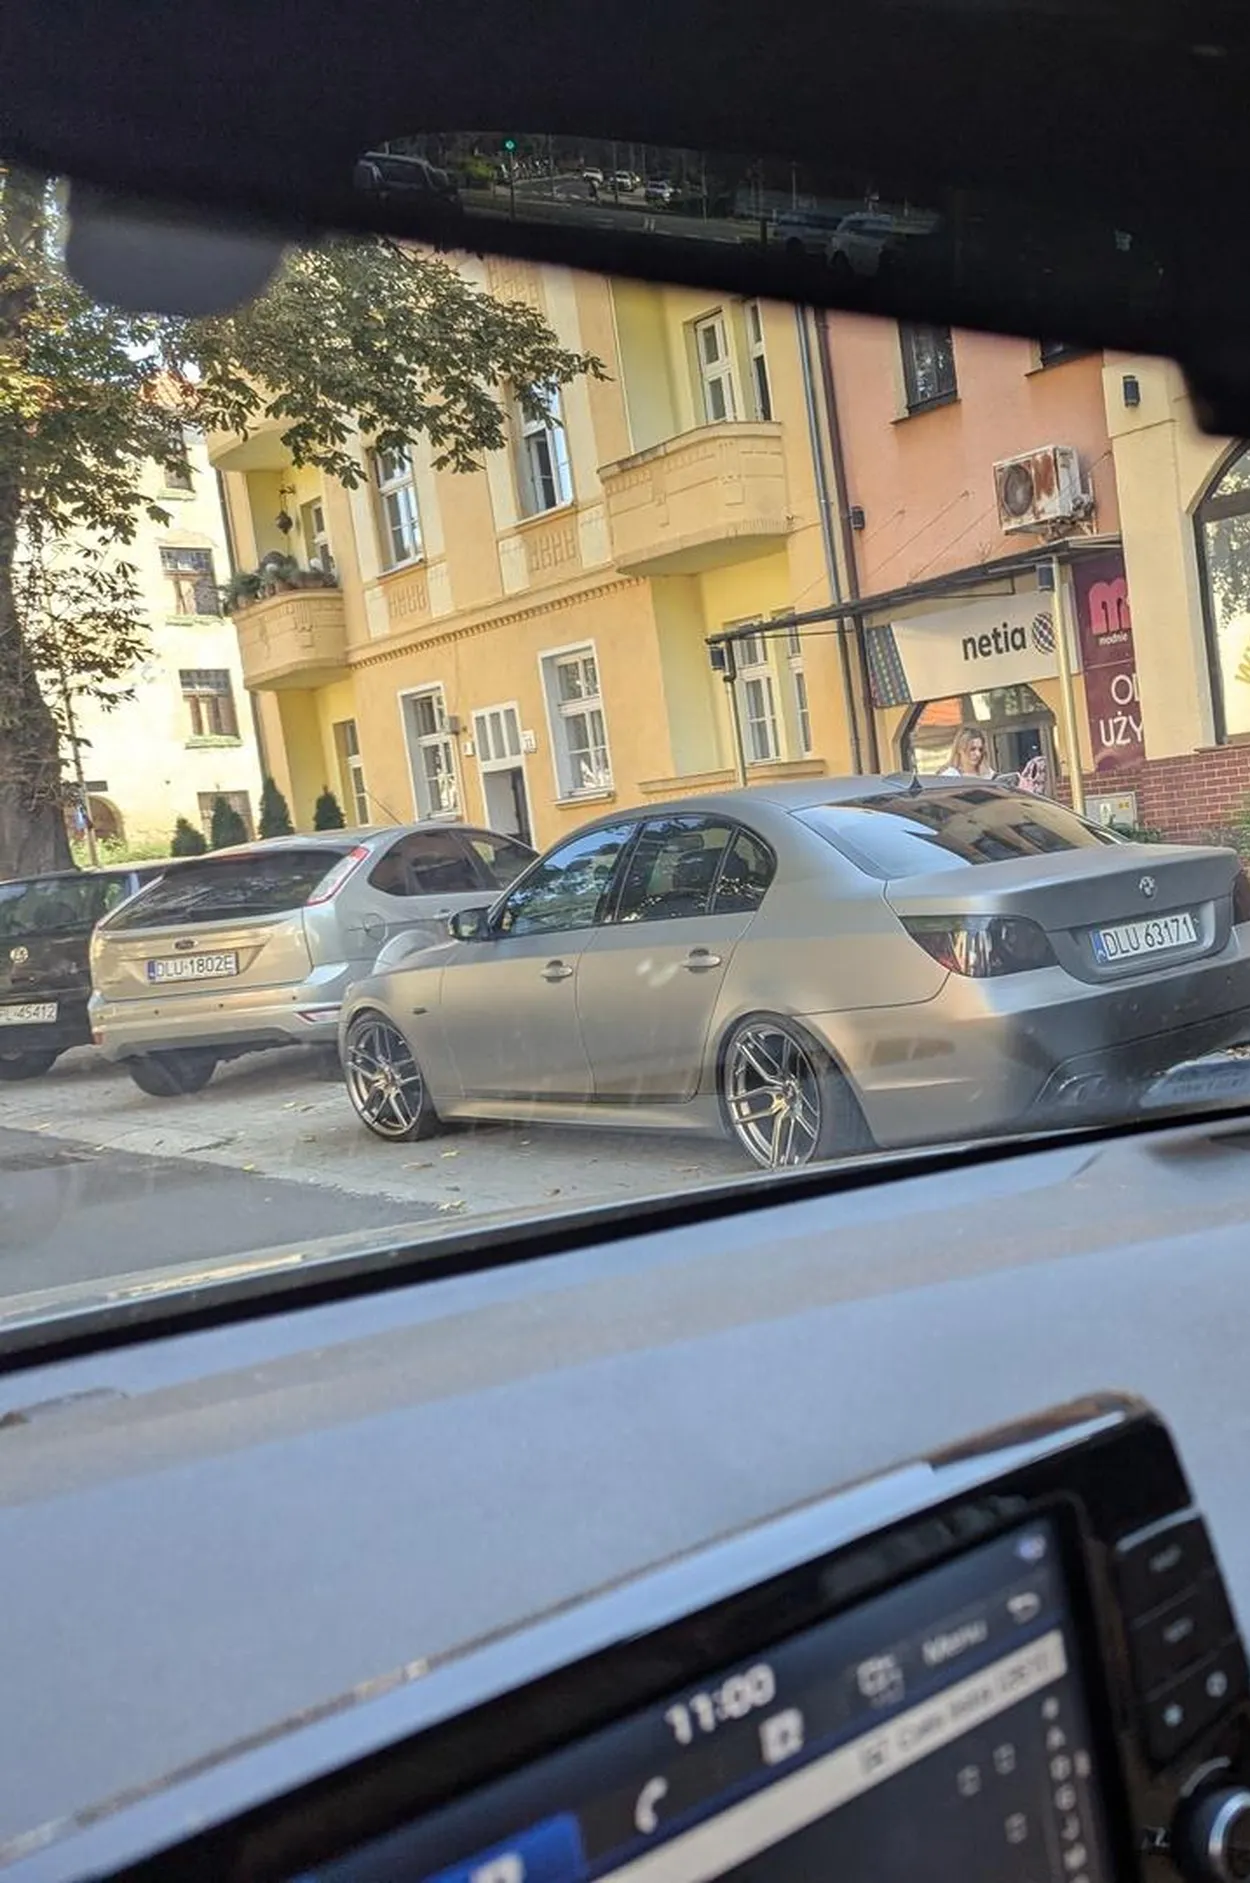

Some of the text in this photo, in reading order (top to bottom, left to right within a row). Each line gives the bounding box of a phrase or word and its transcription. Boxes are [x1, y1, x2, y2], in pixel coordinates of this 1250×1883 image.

[962, 621, 1027, 661] netia
[1103, 915, 1194, 957] DLU 63171
[664, 1662, 776, 1746] 11:00
